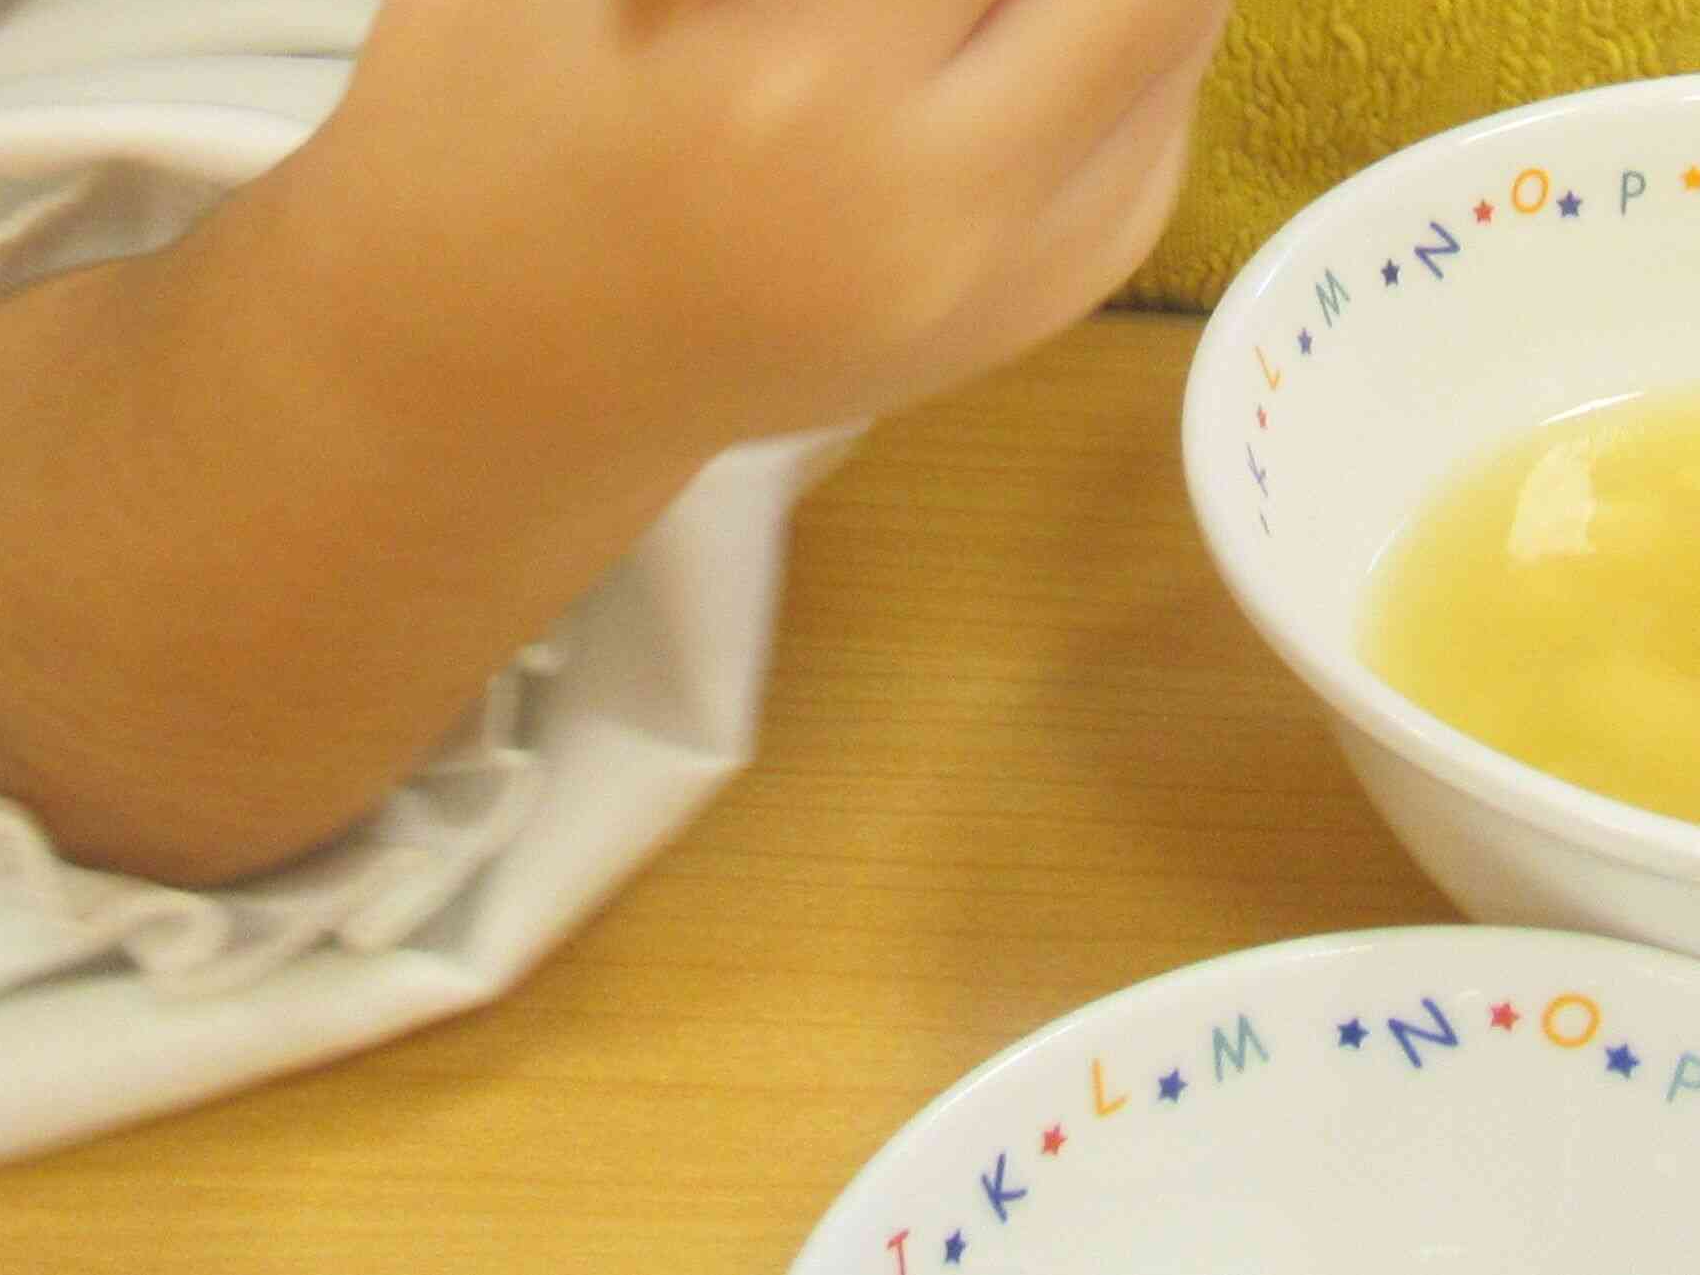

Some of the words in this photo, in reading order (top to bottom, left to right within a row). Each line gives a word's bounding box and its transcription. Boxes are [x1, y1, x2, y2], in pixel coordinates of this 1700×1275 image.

[1316, 268, 1350, 327] M
[1414, 221, 1460, 279] N
[1511, 168, 1549, 214] O
[1620, 170, 1646, 215] P
[981, 1154, 1026, 1222] K
[1092, 1059, 1126, 1119] L
[1212, 1014, 1268, 1082] M
[1387, 998, 1458, 1068] N
[1542, 994, 1600, 1048] O
